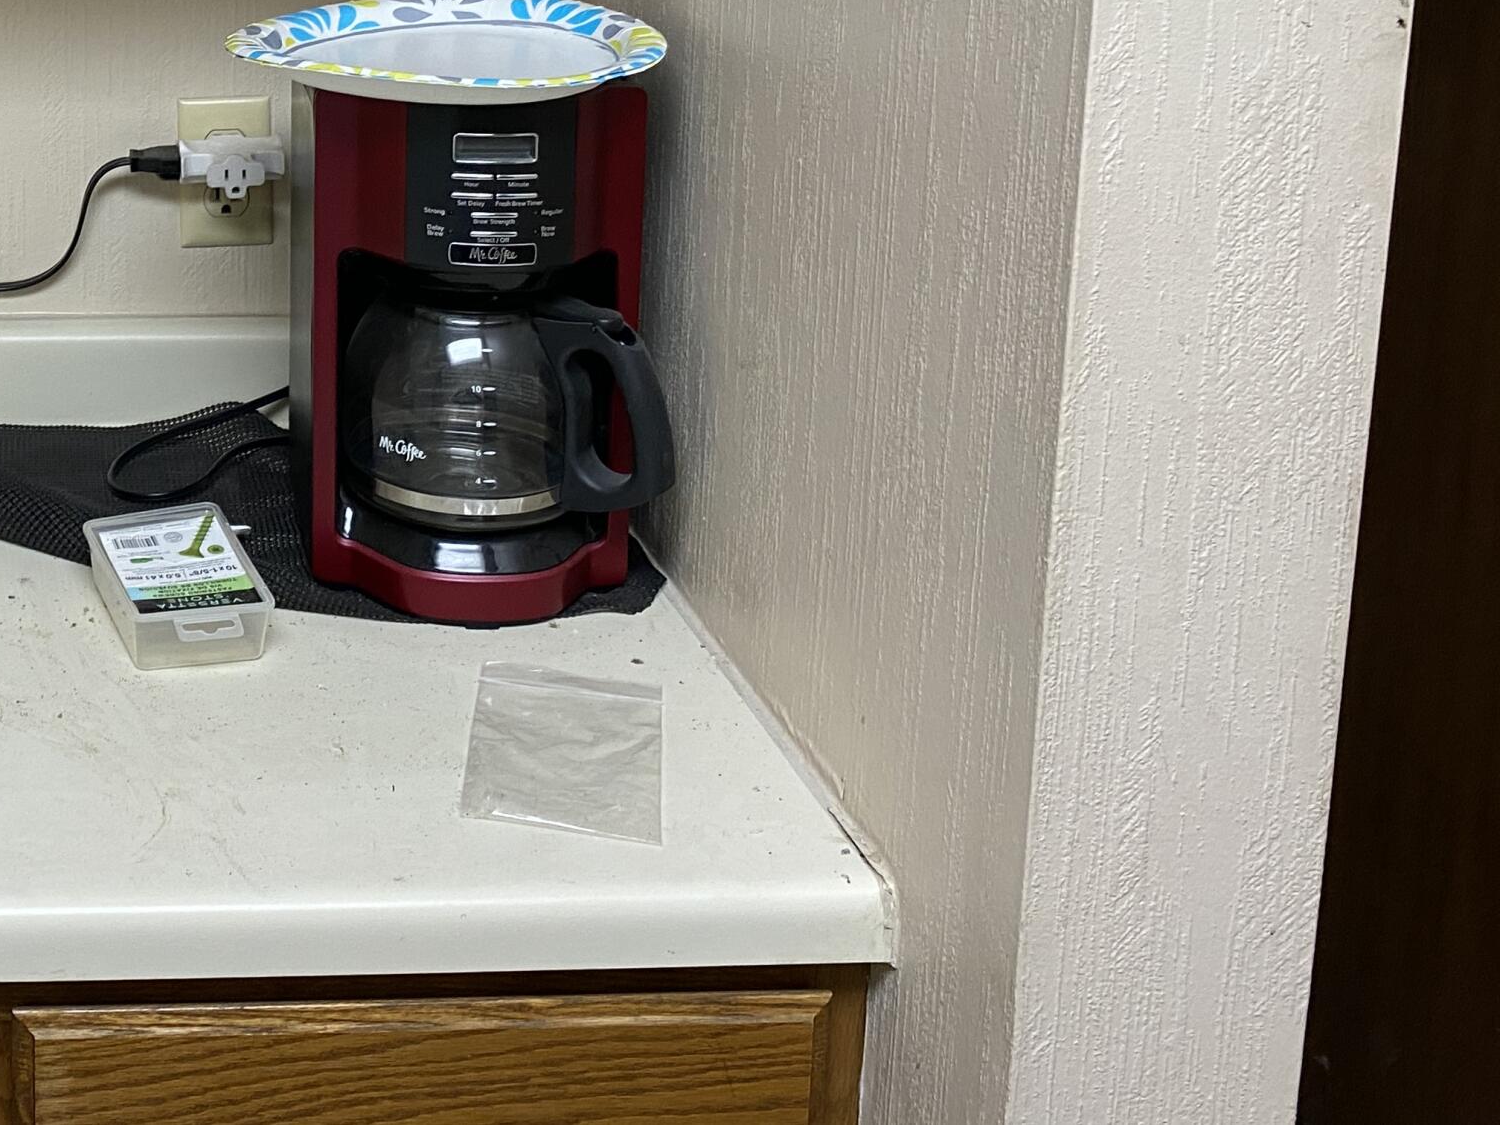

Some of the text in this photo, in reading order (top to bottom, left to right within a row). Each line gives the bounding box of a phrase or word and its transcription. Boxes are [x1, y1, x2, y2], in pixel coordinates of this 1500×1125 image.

[468, 200, 486, 208] Delay
[527, 199, 544, 207] Timer
[423, 206, 446, 216] Strong
[490, 218, 516, 227] Strength
[426, 223, 445, 232] Delay
[487, 247, 518, 263] Coffee
[471, 385, 482, 393] 10
[475, 420, 482, 428] 8
[395, 439, 428, 462] Coffee
[475, 449, 482, 457] 6
[475, 477, 482, 485] 4
[224, 564, 238, 572] 10
[155, 597, 245, 610] VERSETTA
